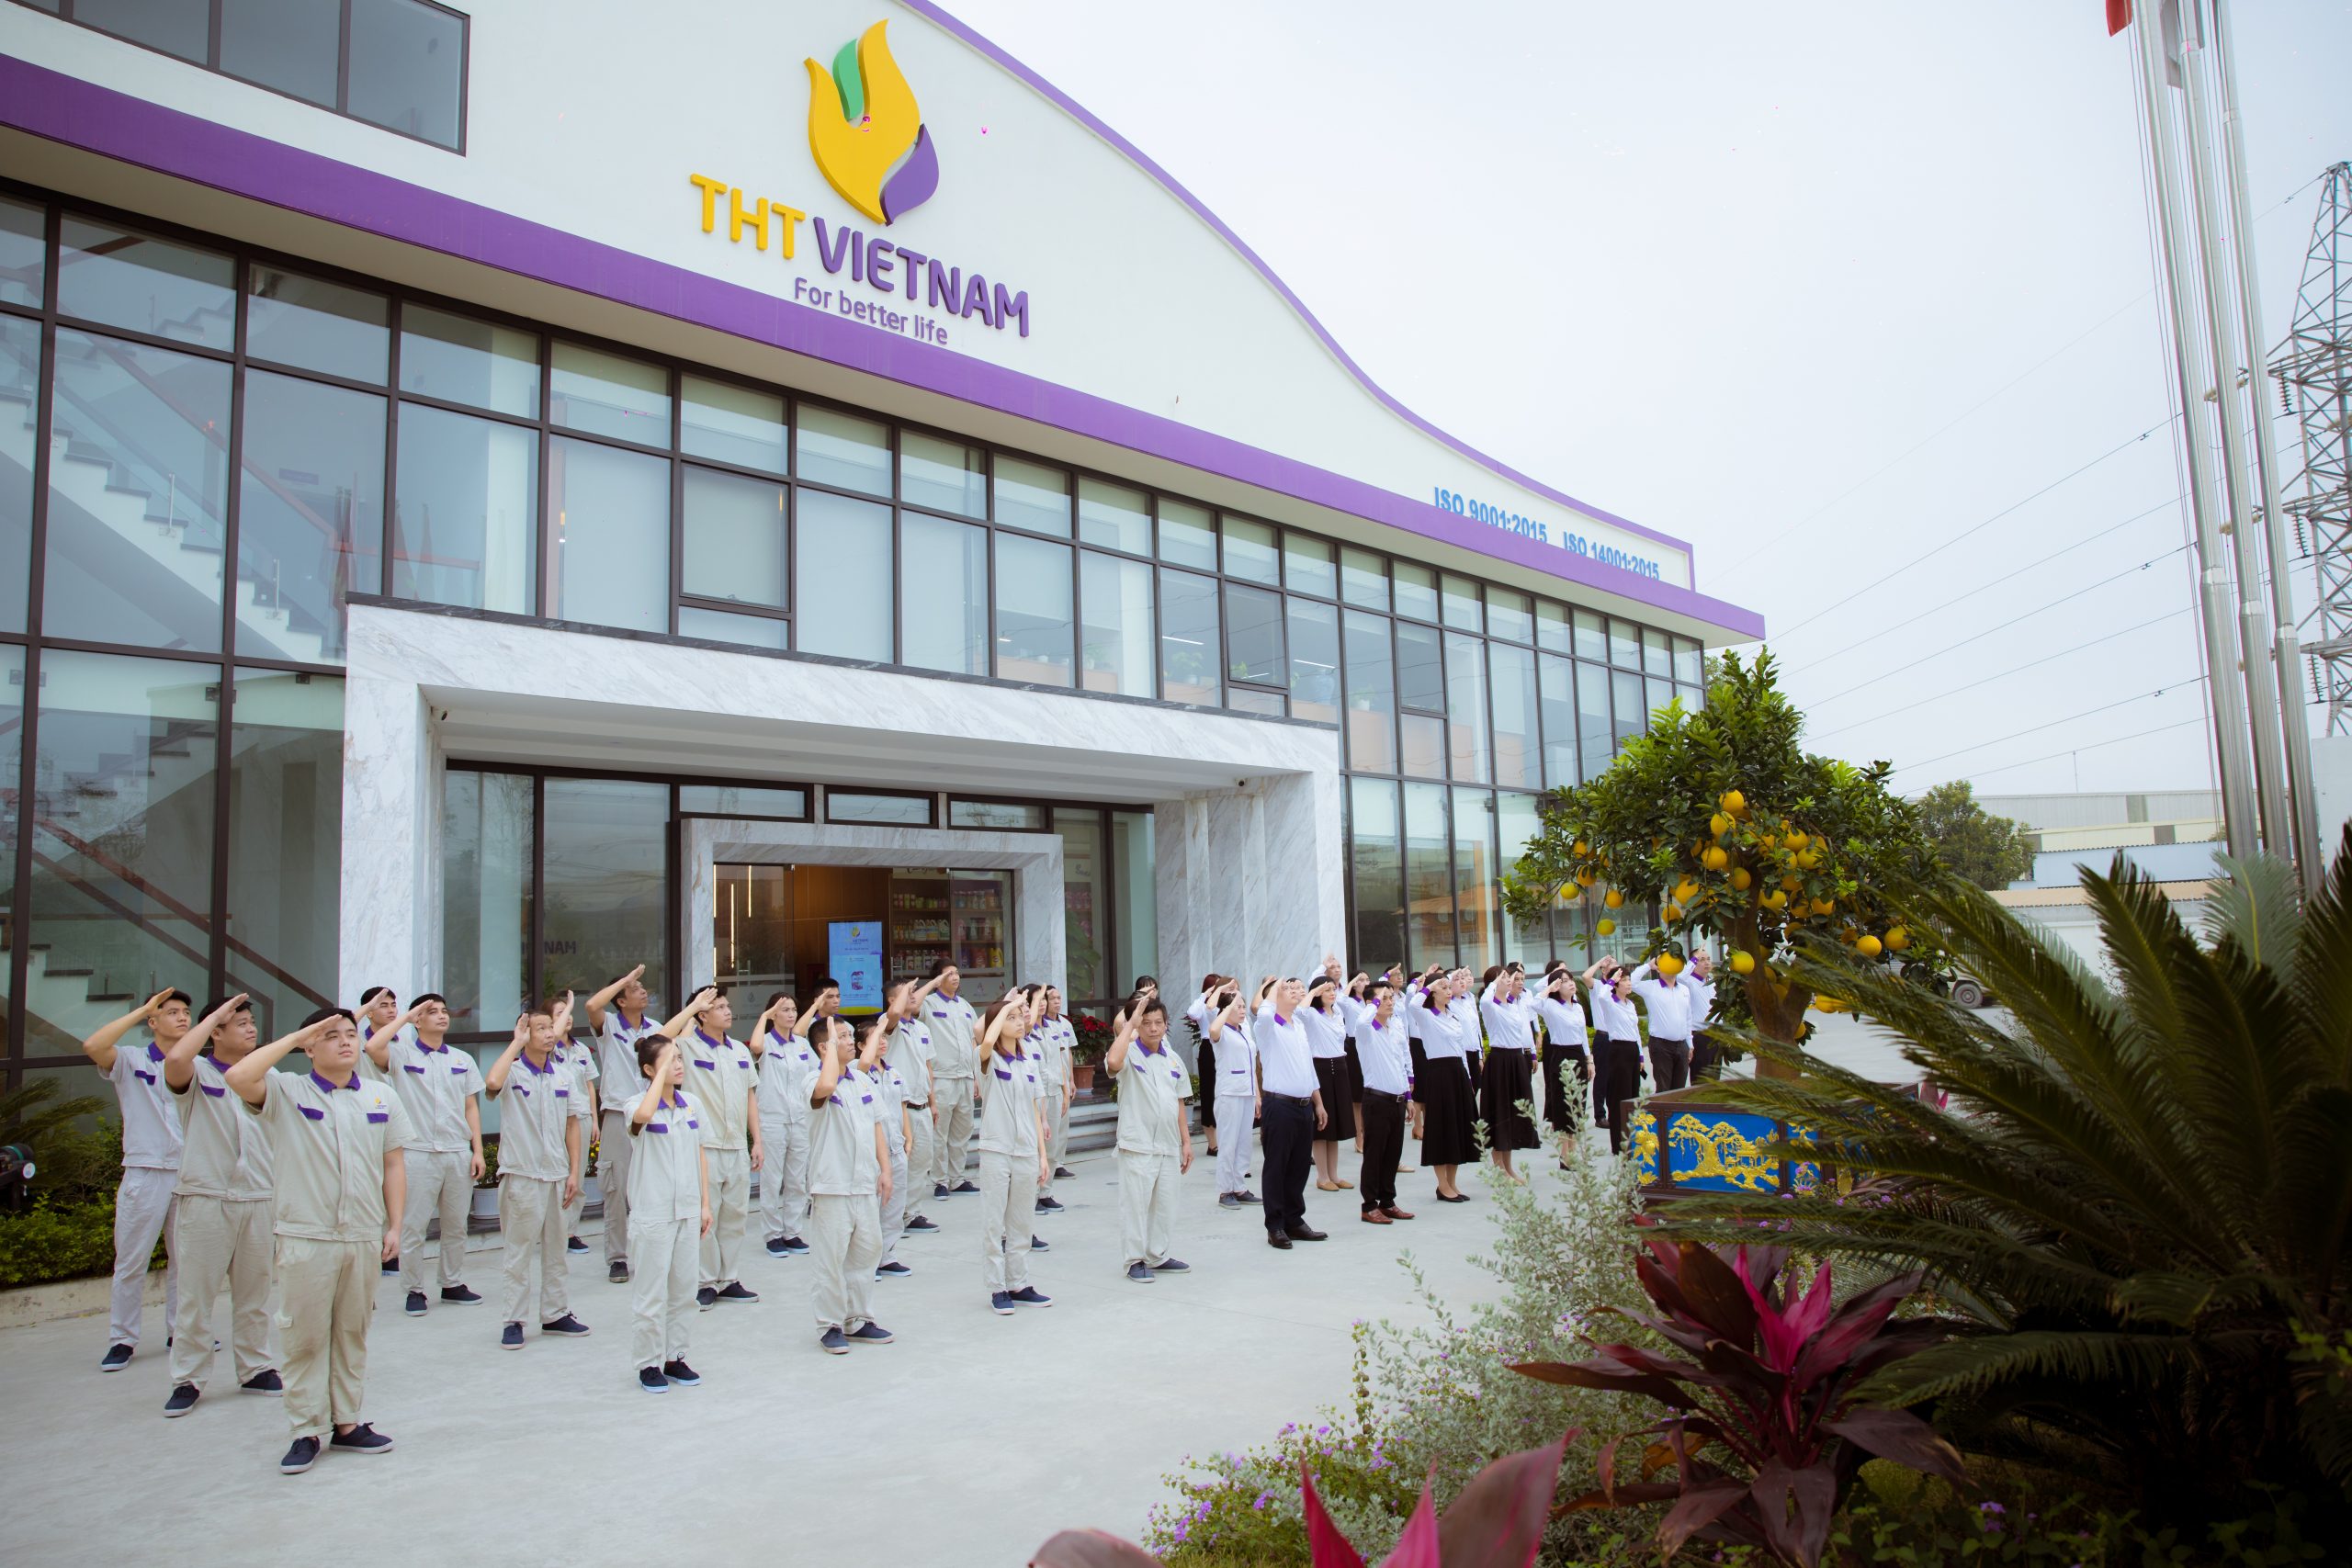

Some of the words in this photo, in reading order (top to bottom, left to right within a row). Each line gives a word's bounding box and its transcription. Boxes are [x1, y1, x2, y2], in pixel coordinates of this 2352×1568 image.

[690, 173, 806, 260] THT
[813, 216, 1030, 338] VIETNAM
[795, 276, 832, 309] For
[839, 289, 909, 333] better
[914, 314, 948, 344] life
[1434, 486, 1464, 515] ISO
[1469, 499, 1547, 544] 9001:2015
[1563, 531, 1587, 557] ISO
[1591, 541, 1659, 581] 14001:2015
